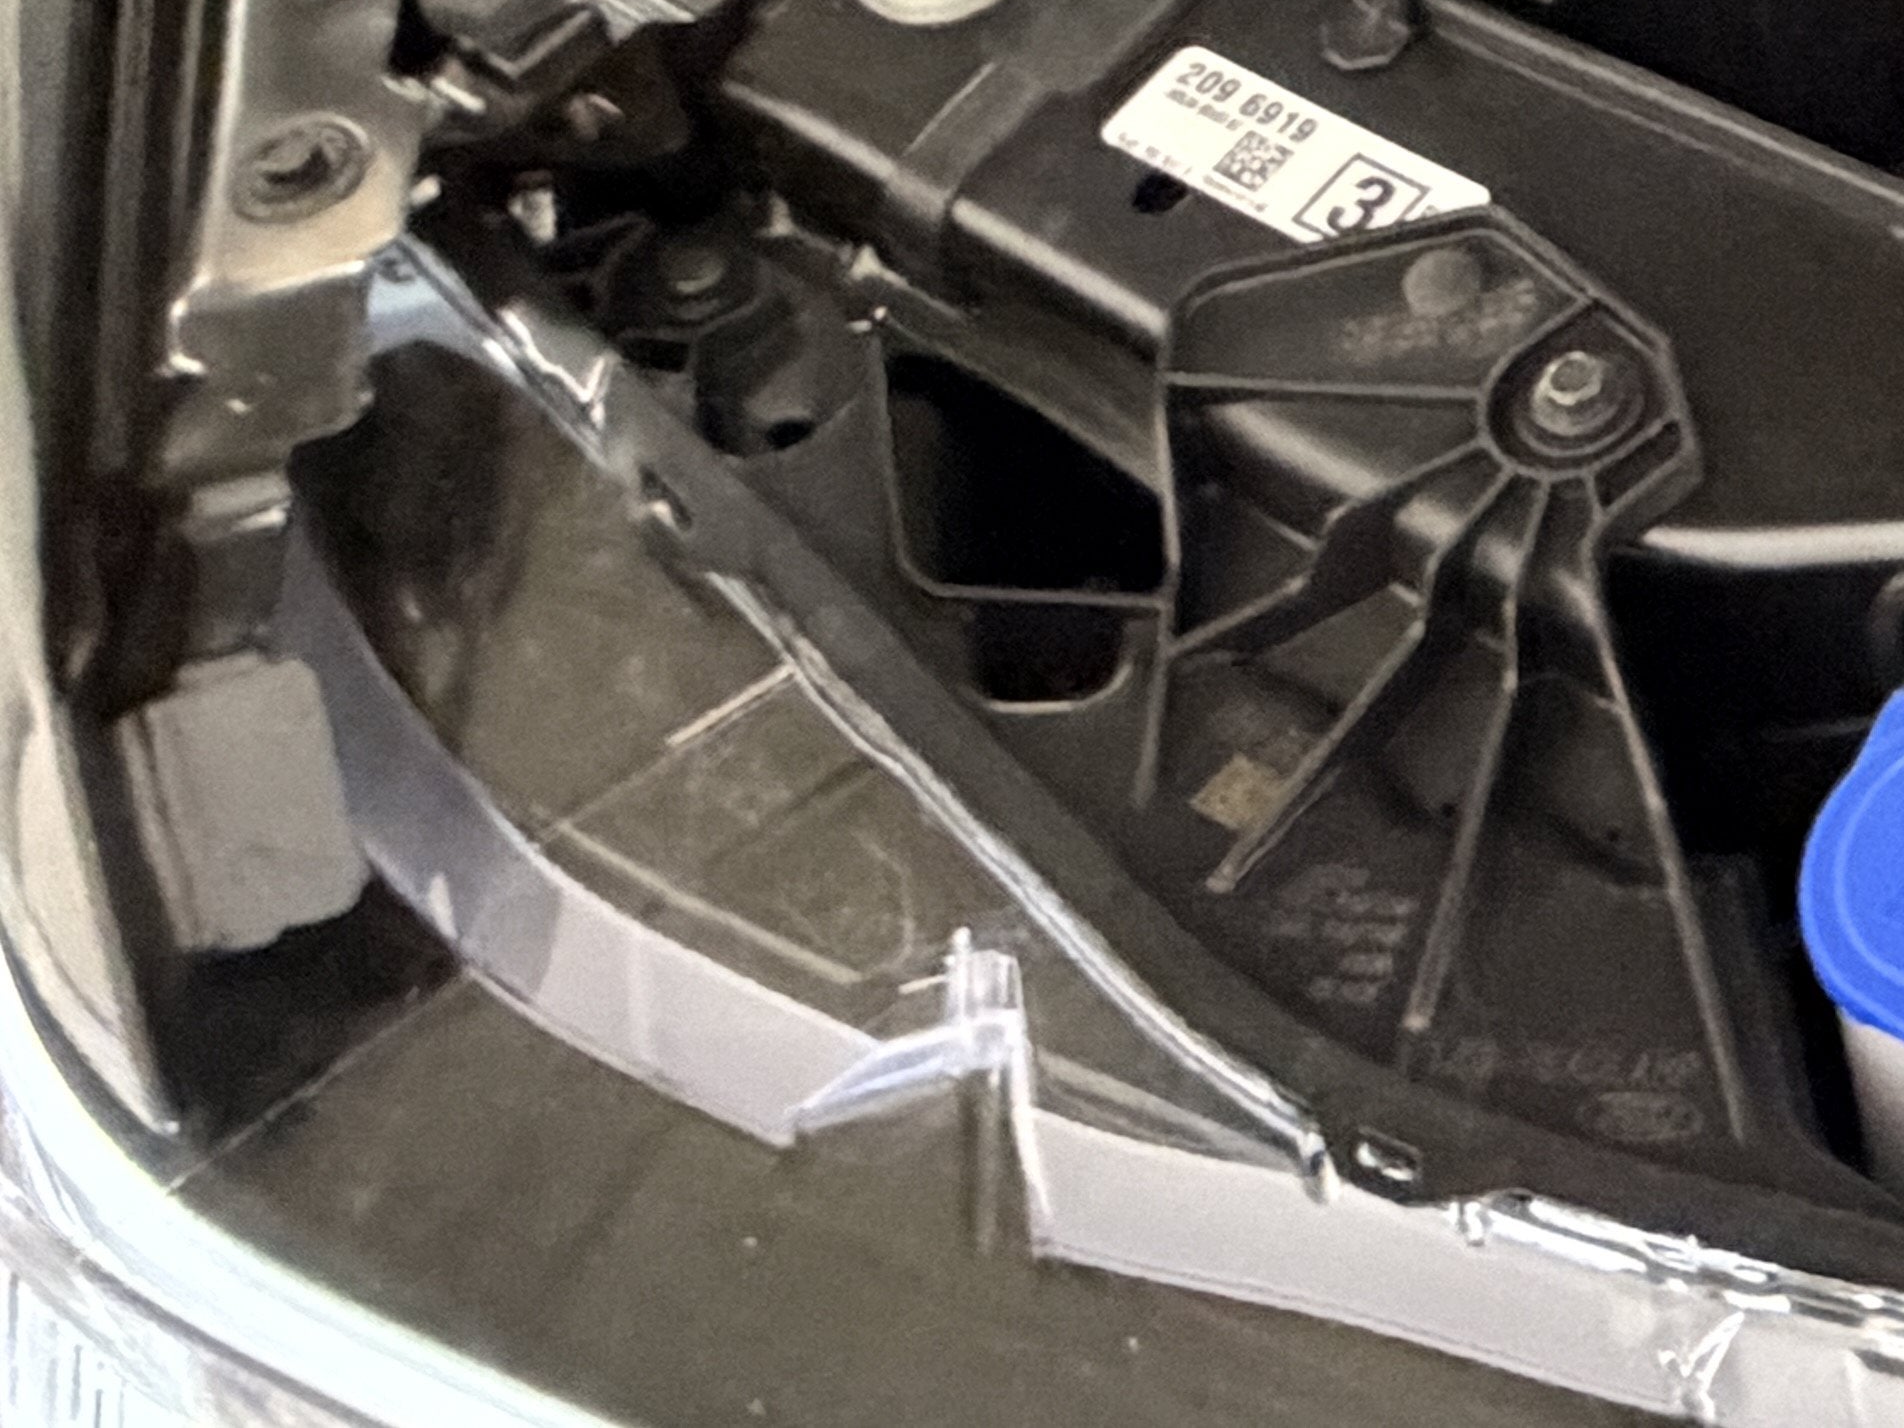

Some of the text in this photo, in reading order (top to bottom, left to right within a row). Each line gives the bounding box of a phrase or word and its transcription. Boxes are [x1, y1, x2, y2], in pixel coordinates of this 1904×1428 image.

[1176, 62, 1242, 102] 209
[1239, 93, 1318, 143] 6919
[1327, 175, 1396, 234] 3
